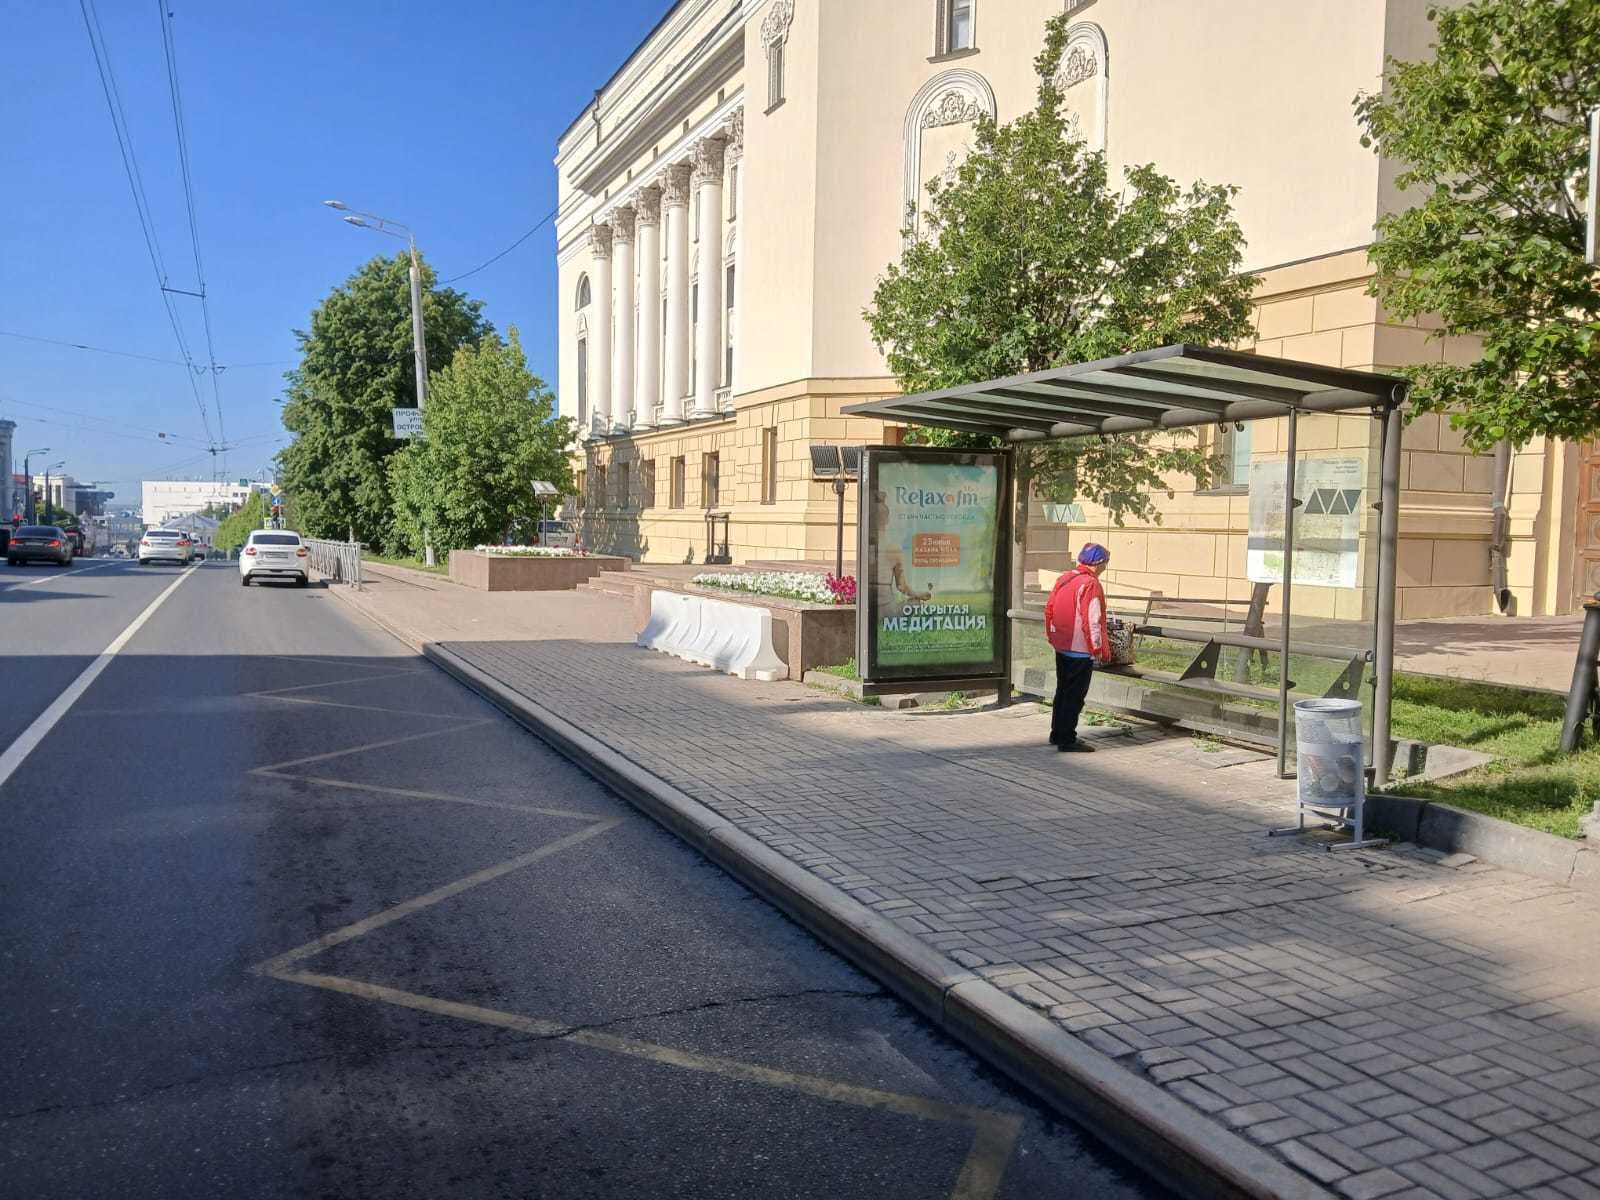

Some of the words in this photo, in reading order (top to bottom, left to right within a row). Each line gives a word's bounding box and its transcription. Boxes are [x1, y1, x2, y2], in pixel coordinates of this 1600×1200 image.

[896, 486, 945, 508] Relax
[902, 604, 969, 615] ОТКРЫТАЯ
[882, 615, 986, 632] МЕДИТАЦИЯ
